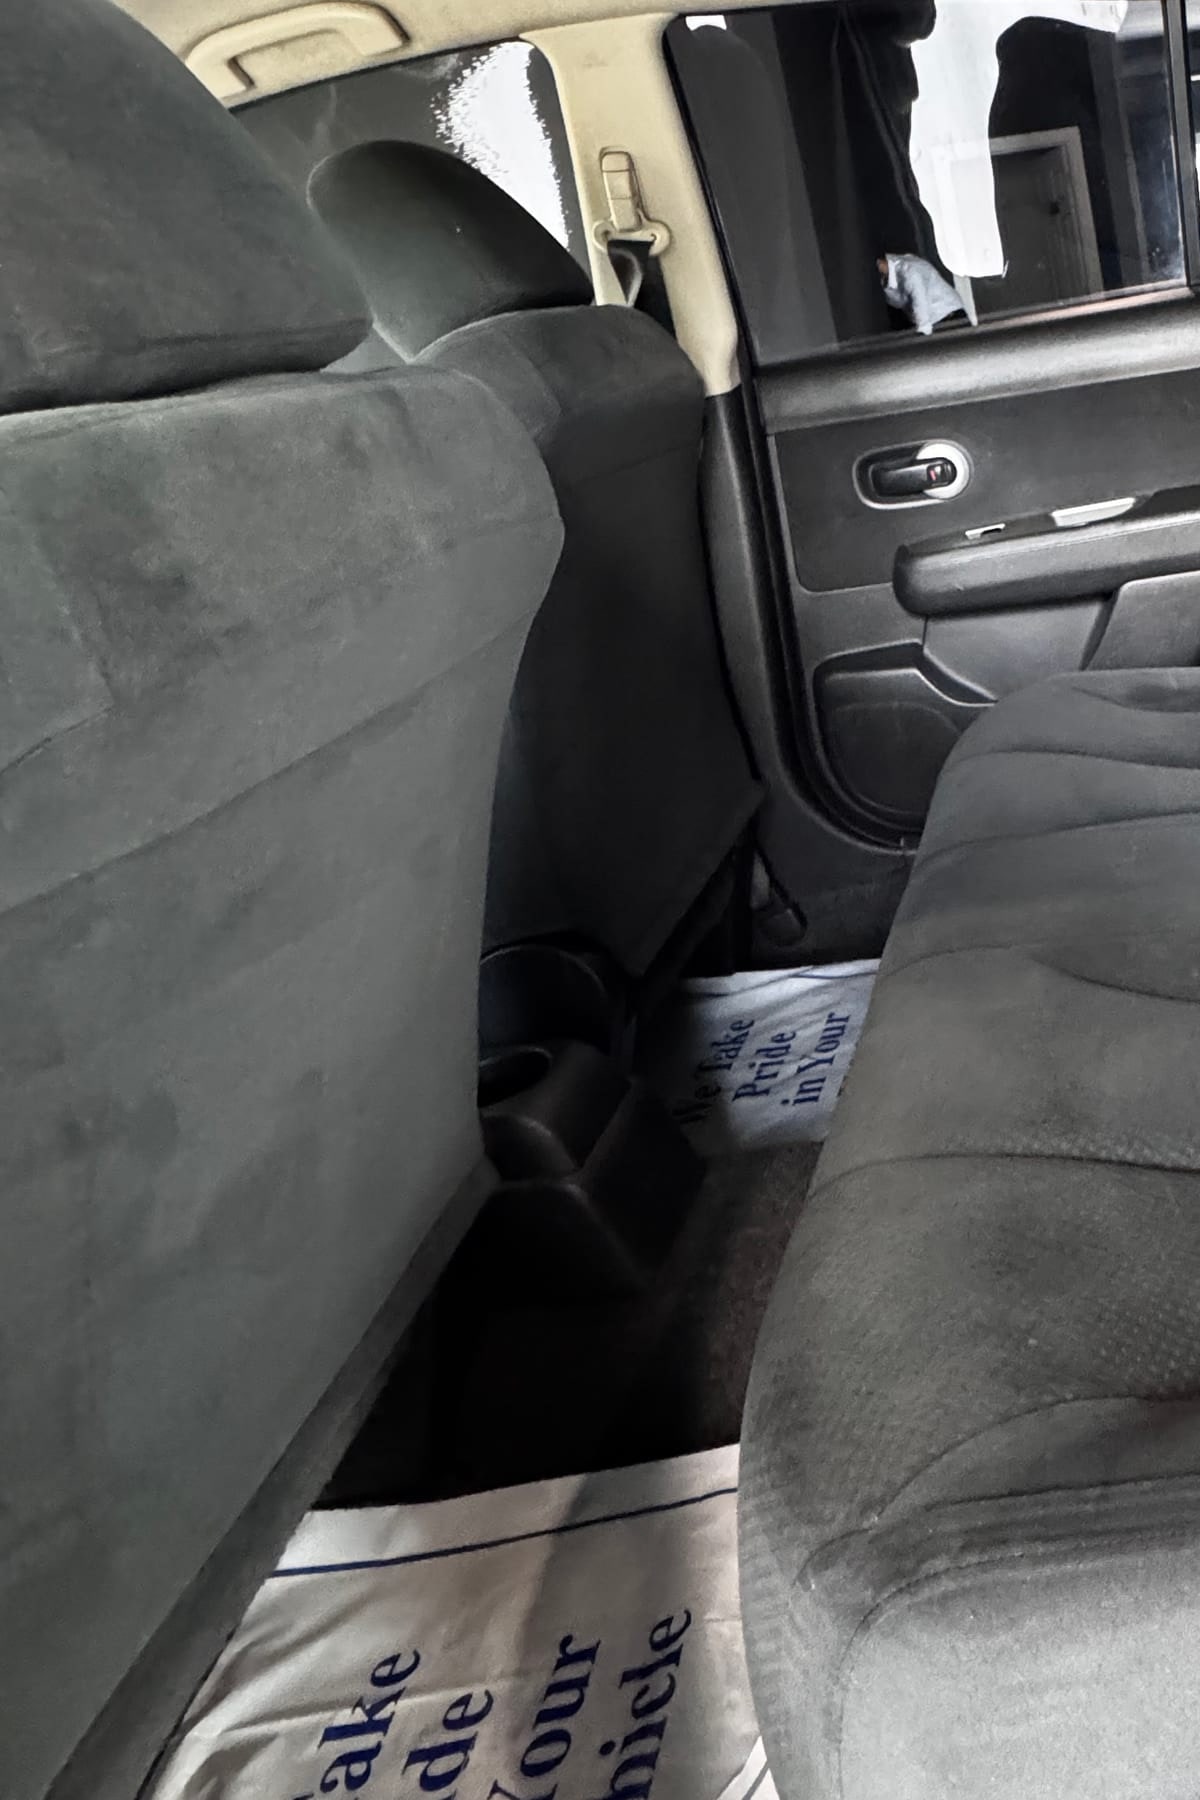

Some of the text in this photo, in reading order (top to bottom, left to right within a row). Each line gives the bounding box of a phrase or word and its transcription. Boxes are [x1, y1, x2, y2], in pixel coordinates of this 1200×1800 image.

[732, 1030, 797, 1102] Pride
[780, 1012, 850, 1107] in Your
[293, 1649, 421, 1800] ake
